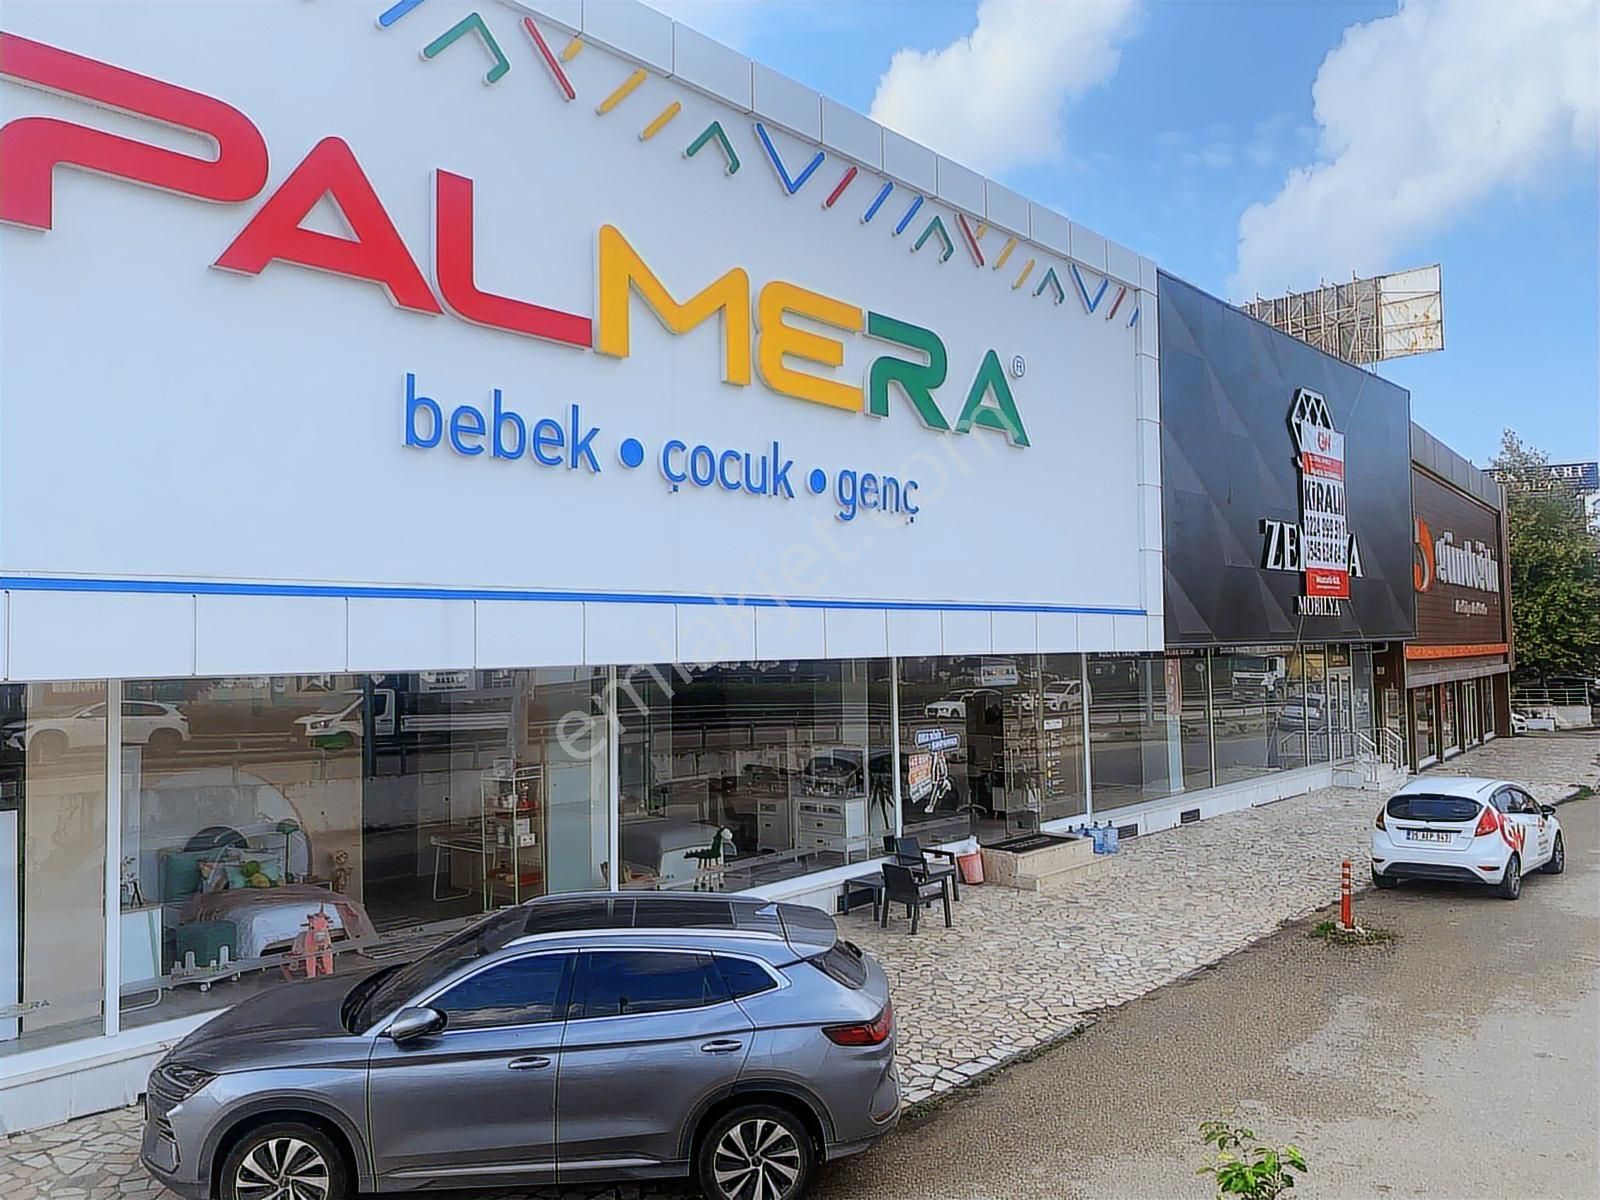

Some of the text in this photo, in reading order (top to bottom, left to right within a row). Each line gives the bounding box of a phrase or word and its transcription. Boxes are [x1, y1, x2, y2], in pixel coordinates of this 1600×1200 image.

[0, 31, 1031, 448] PALMERA
[402, 373, 921, 525] bebek çocuk genç
